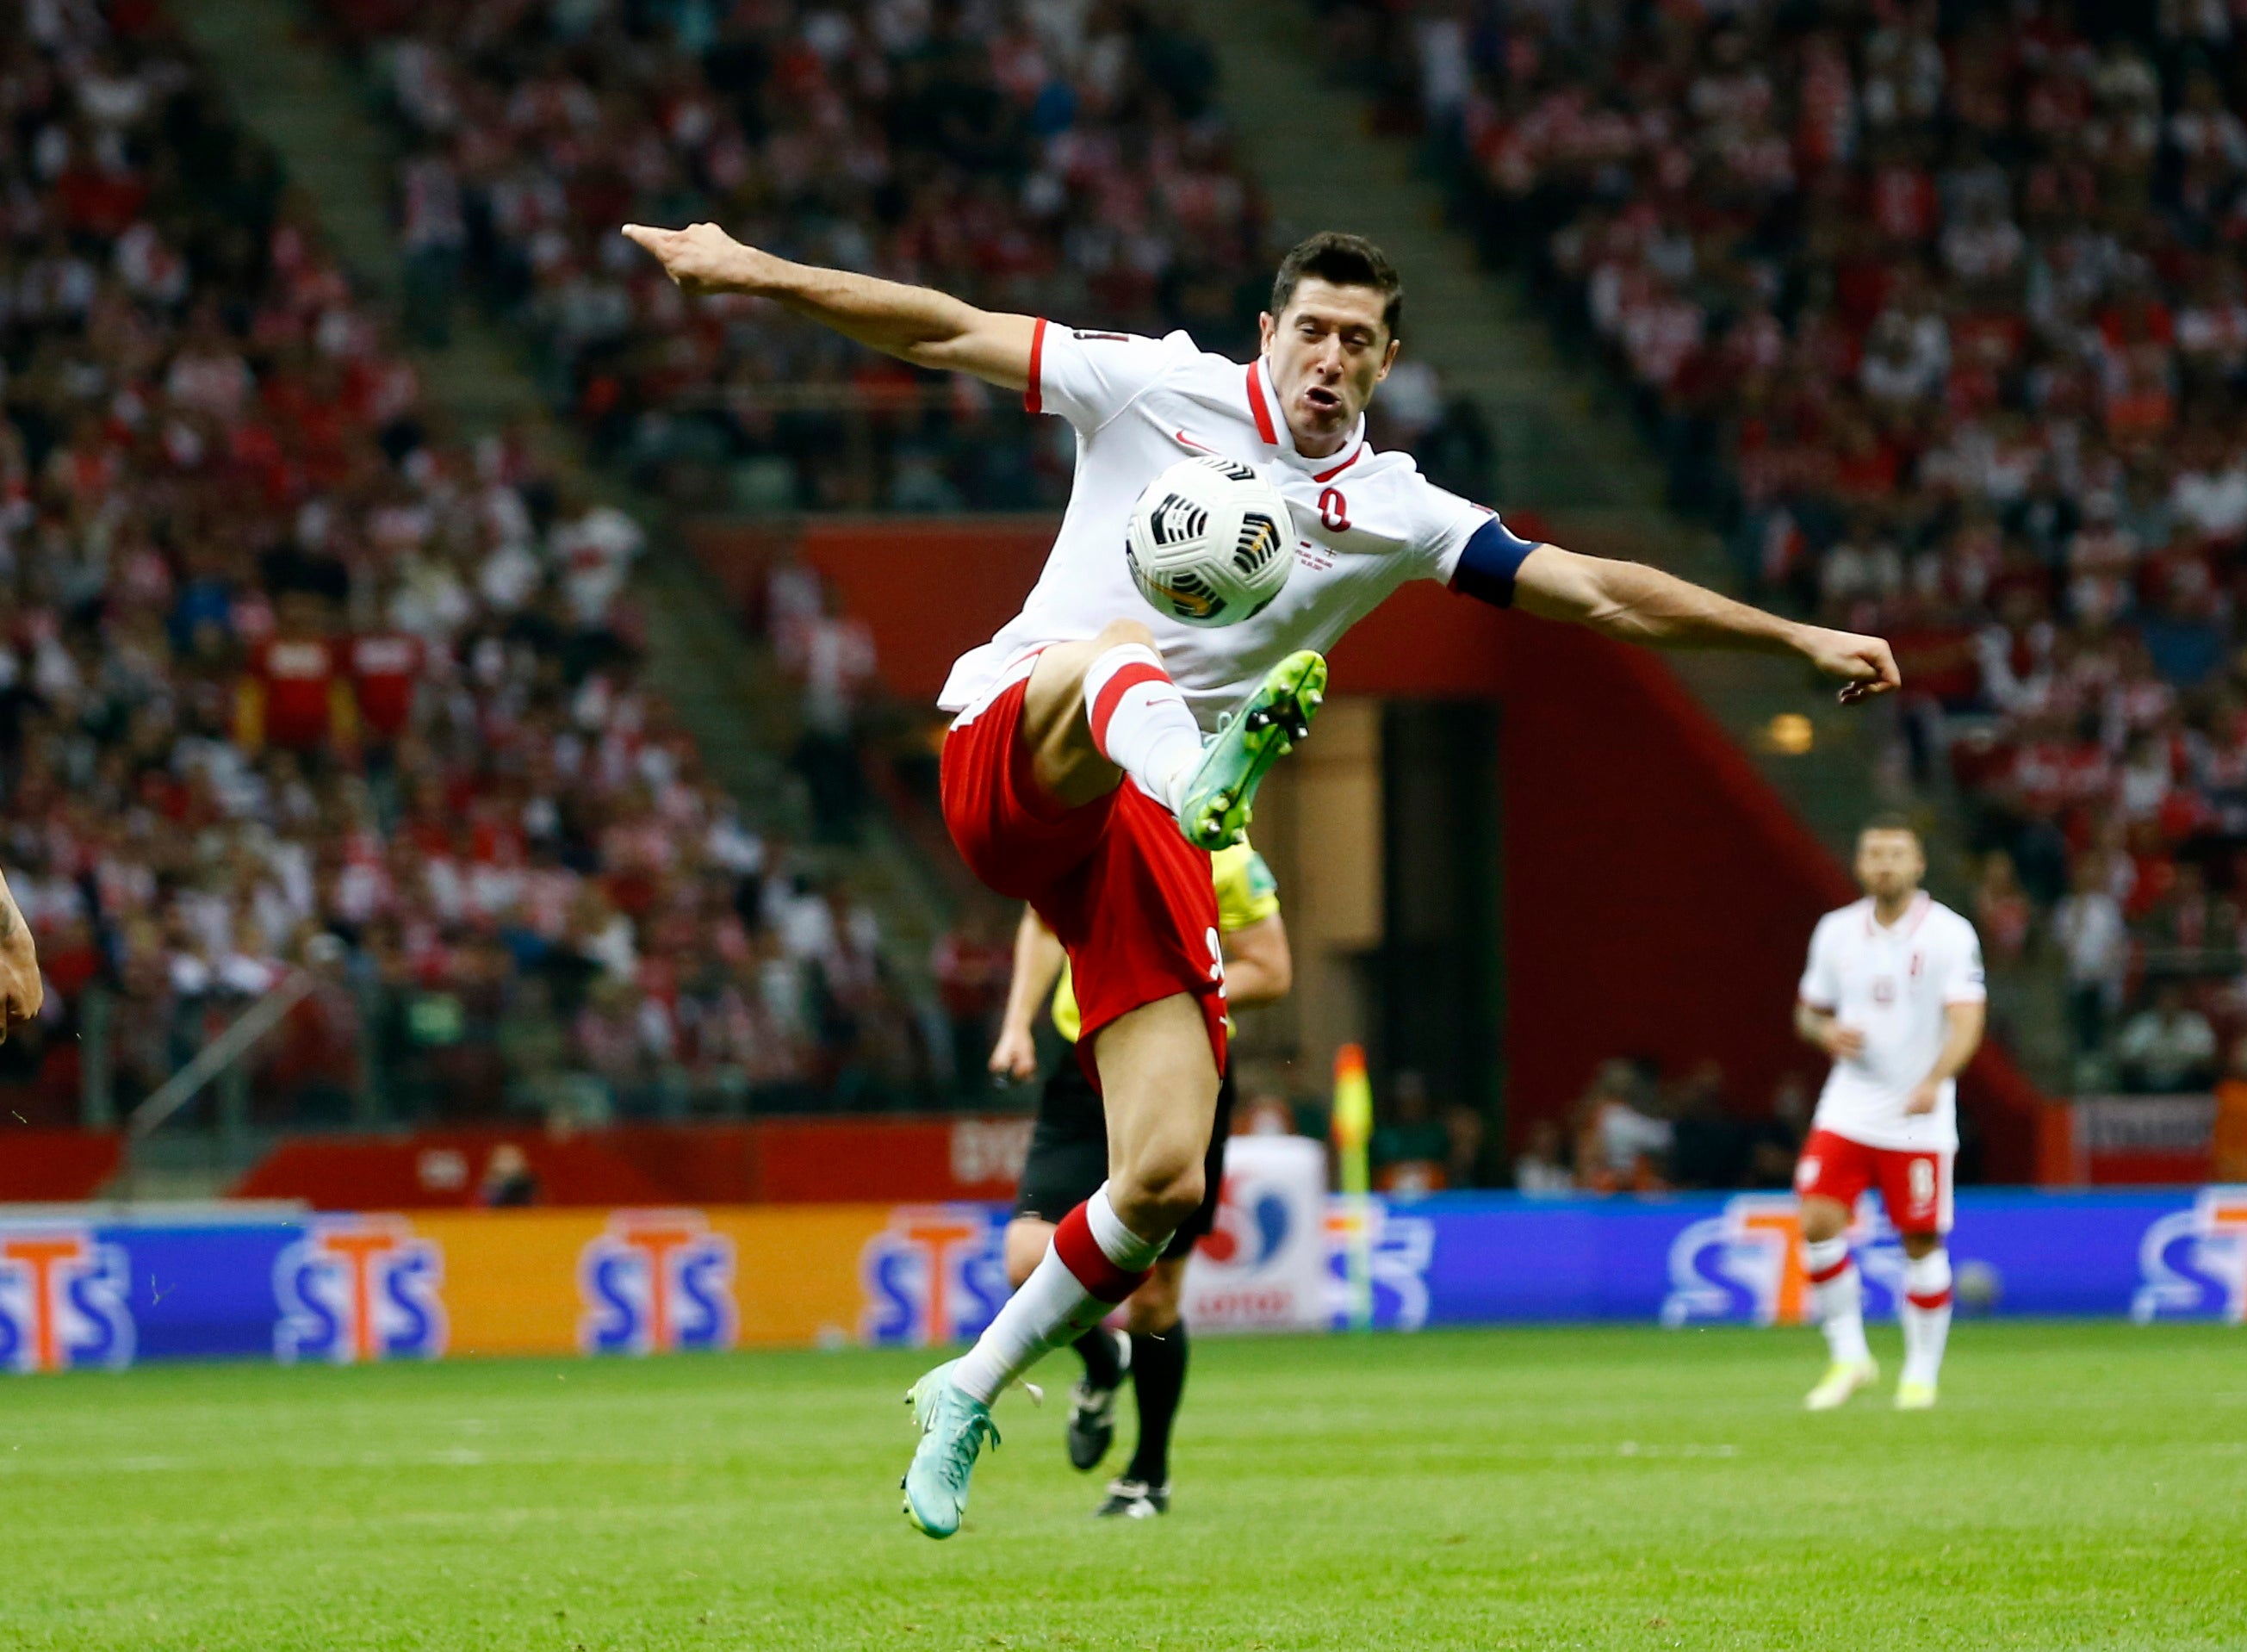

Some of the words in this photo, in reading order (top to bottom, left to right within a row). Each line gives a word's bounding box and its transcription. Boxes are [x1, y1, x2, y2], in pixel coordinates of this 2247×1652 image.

[0, 1235, 127, 1371] TS
[282, 1227, 441, 1361] STS
[584, 1220, 729, 1354] STS
